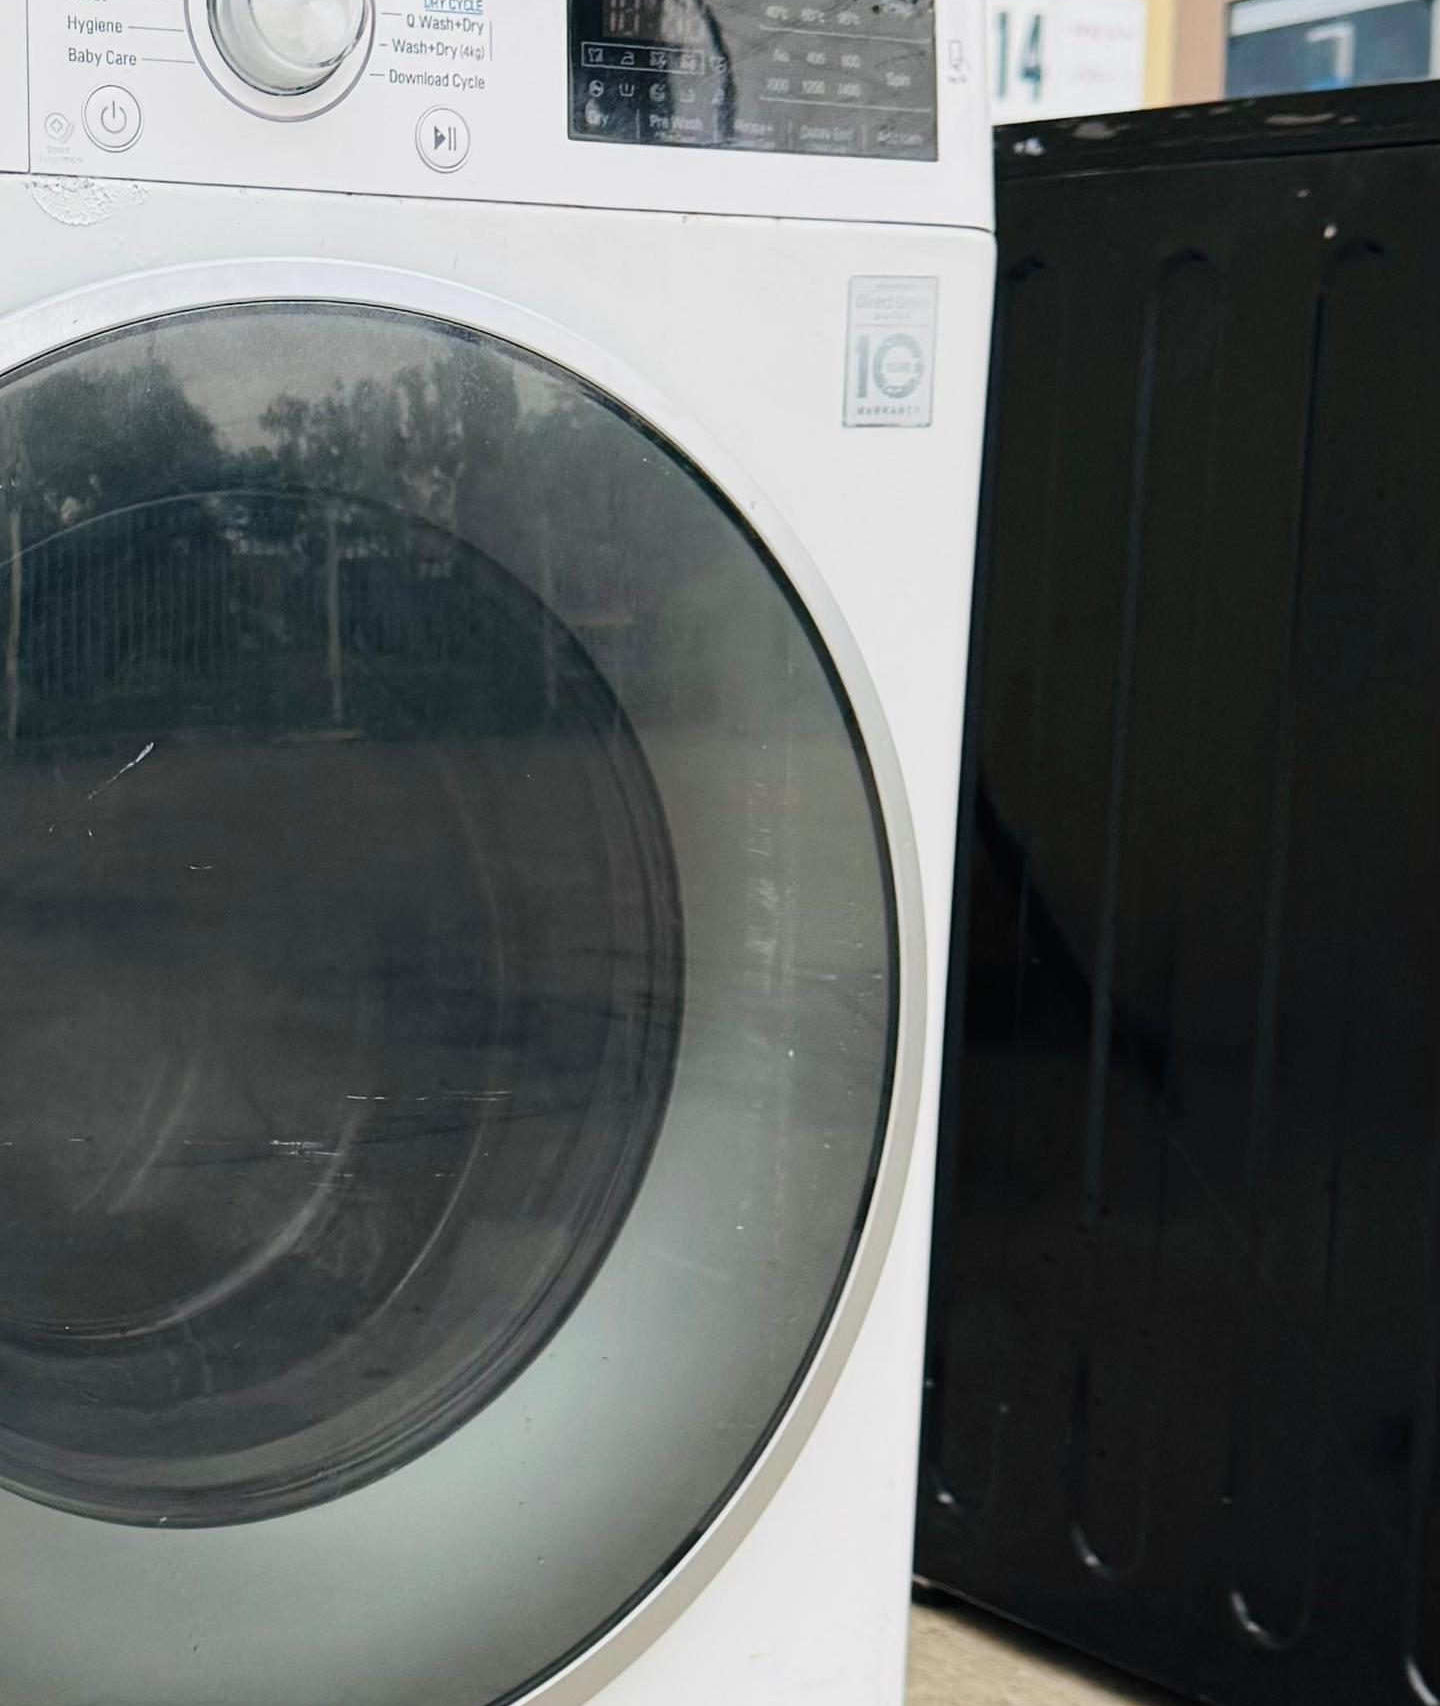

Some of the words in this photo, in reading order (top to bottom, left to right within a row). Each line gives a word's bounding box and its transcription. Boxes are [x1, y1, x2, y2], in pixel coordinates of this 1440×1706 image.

[67, 15, 122, 34] Hygiene
[68, 47, 102, 67] Baby
[106, 50, 137, 66] Care
[392, 38, 457, 60] Wash+Dry
[389, 69, 449, 87] Download
[453, 73, 485, 91] Cycle
